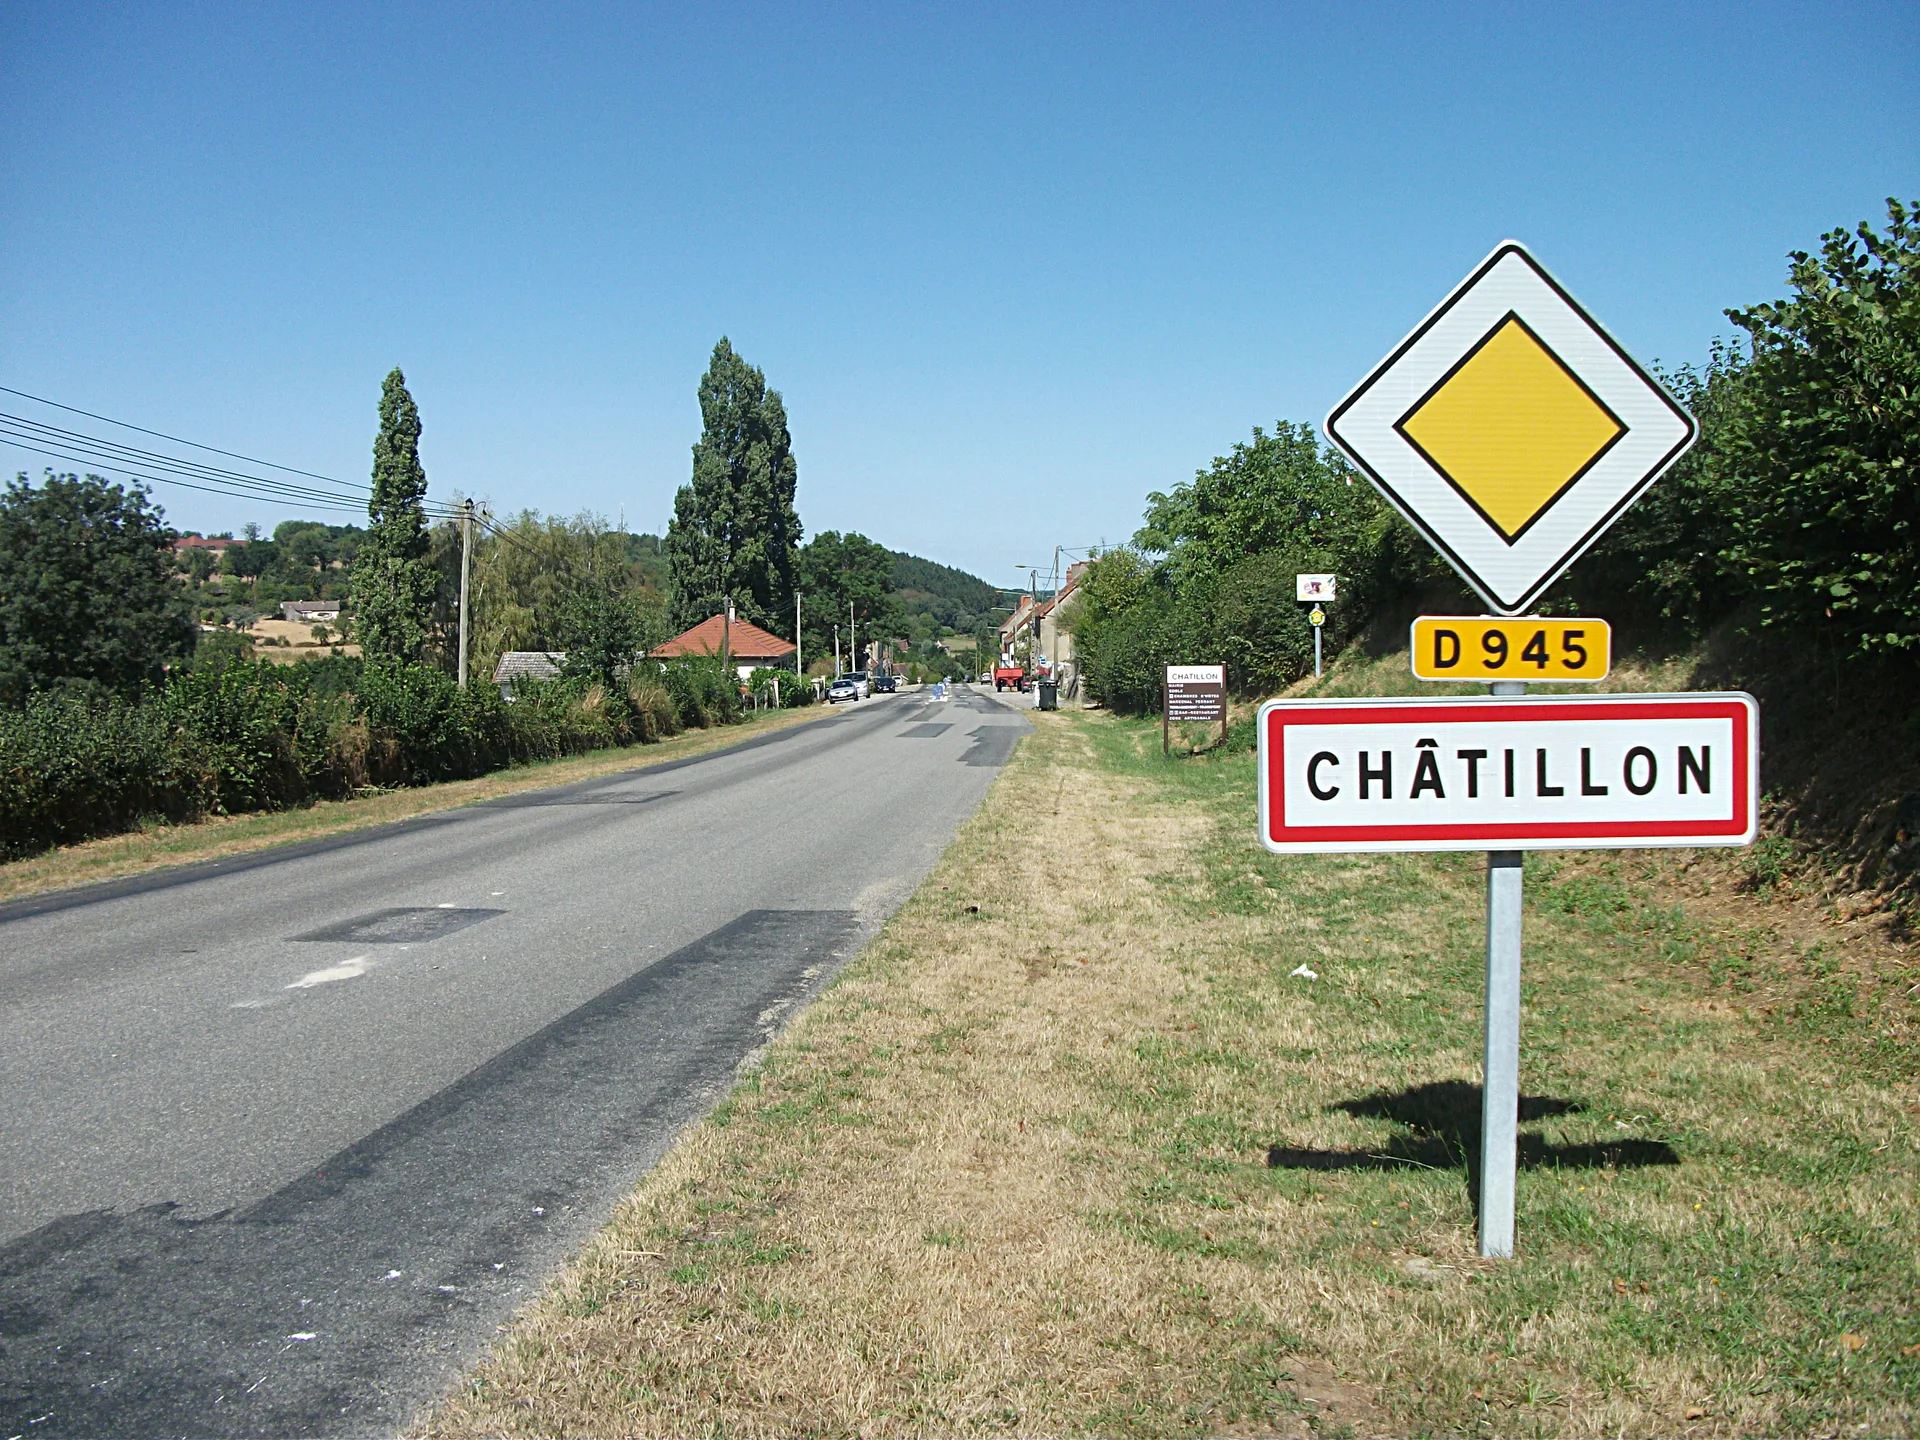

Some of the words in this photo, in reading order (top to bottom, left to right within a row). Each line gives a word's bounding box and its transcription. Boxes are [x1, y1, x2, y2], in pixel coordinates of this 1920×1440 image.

[1433, 630, 1460, 669] D
[1481, 629, 1588, 669] 945
[1306, 738, 1711, 801] CHÂTILLON
